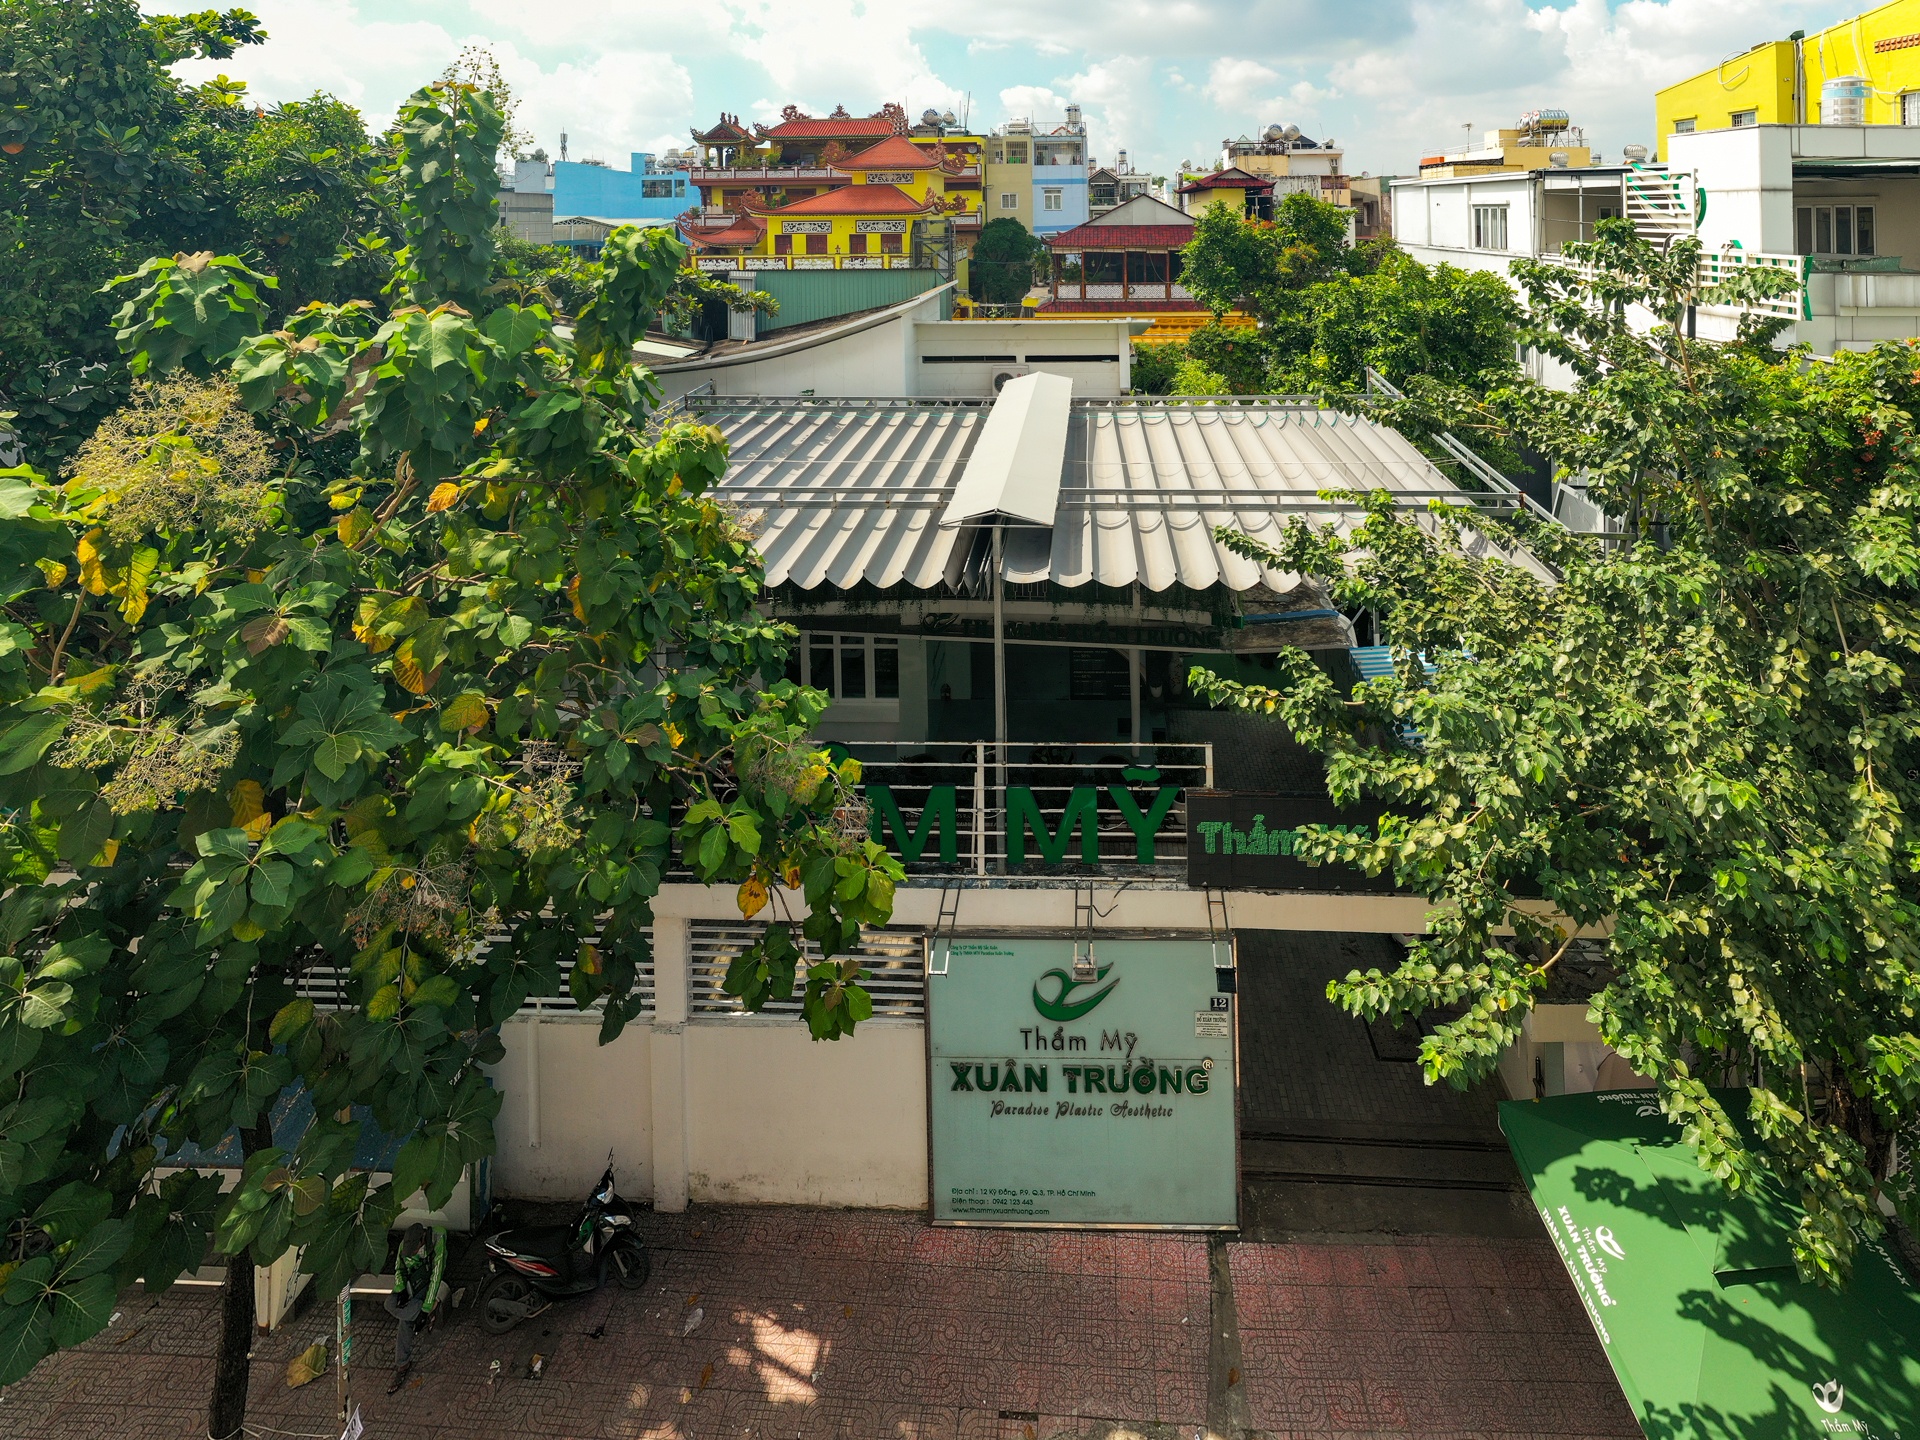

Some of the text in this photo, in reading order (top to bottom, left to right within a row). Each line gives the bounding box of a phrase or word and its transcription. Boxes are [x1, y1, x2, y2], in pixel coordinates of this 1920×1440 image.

[1006, 764, 1180, 864] MỸ
[1212, 998, 1227, 1008] 12
[1020, 1026, 1138, 1058] Thẩm Mỹ
[950, 1058, 1048, 1093] XUÂN
[990, 1100, 1173, 1120] Paradise Plastic Aesthetic
[1557, 1205, 1581, 1244] XUÂN
[1820, 1417, 1870, 1436] Thẩm Mỹ
